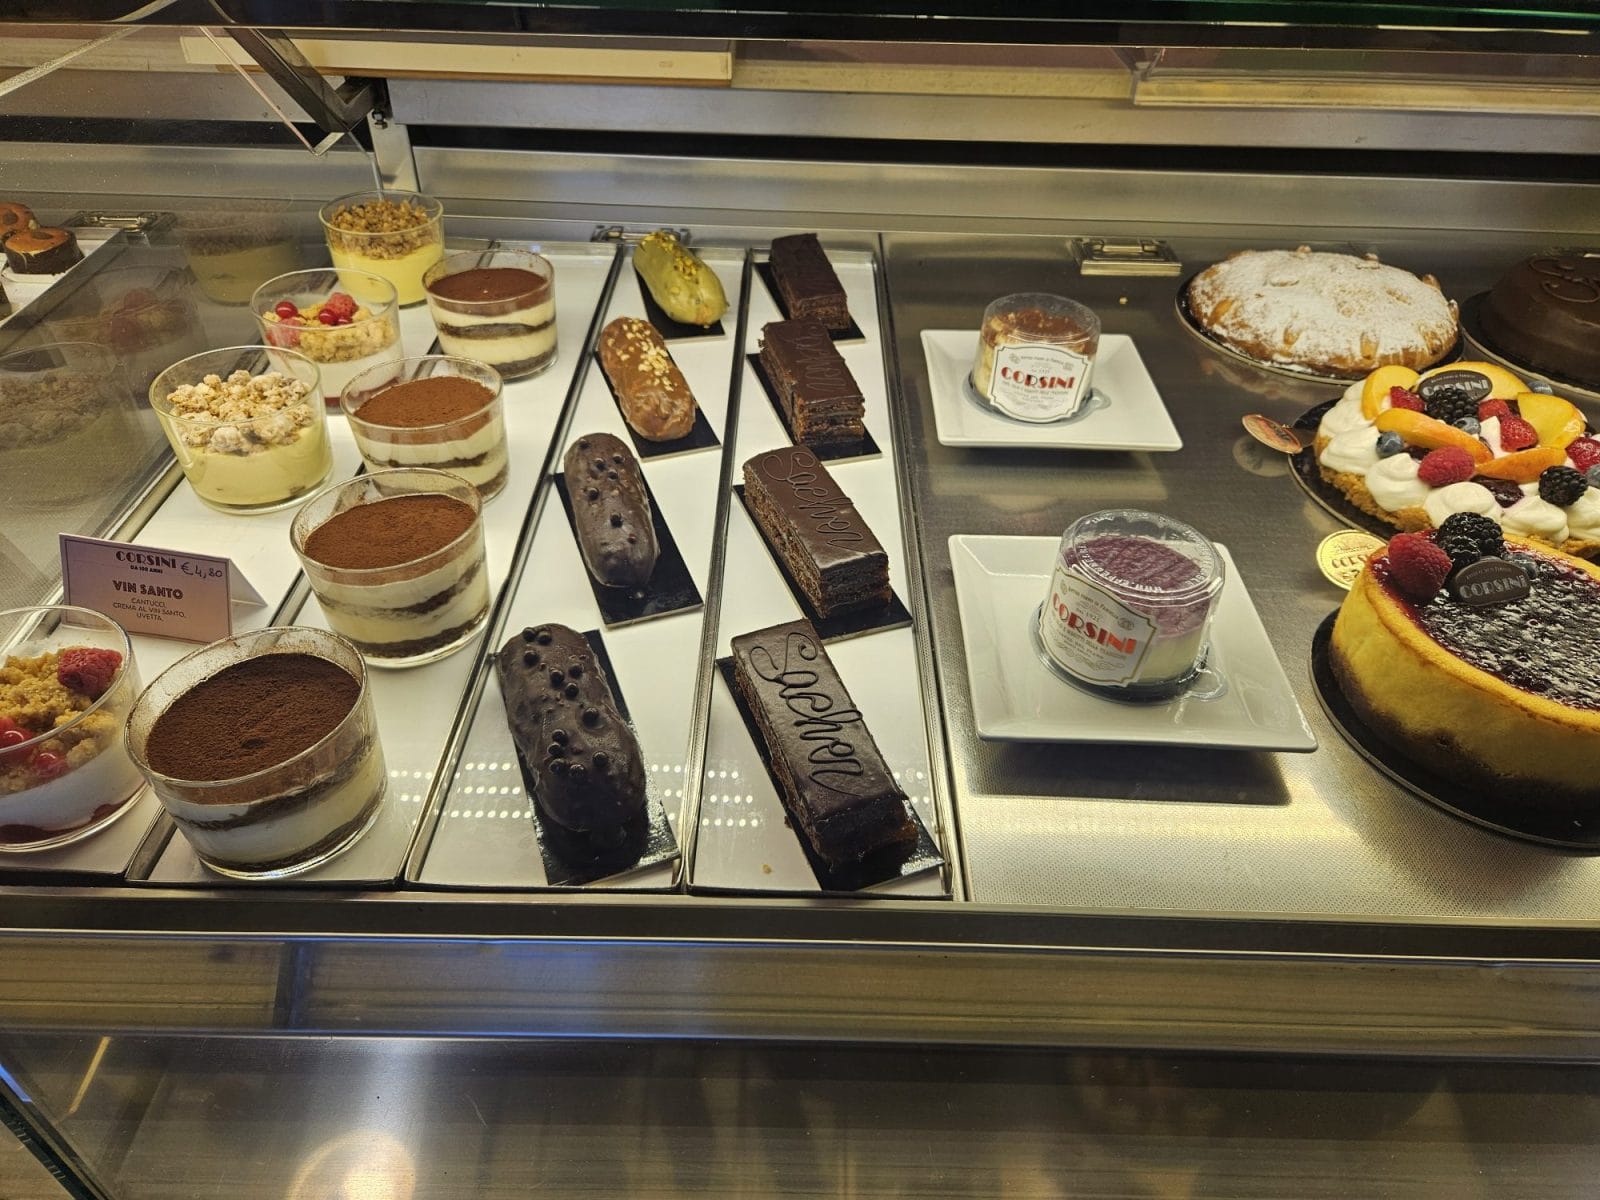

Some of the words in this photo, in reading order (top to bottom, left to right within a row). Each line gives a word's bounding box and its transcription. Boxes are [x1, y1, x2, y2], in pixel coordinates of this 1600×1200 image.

[1001, 367, 1075, 389] CORSINI
[115, 550, 177, 569] CORSINI
[112, 579, 137, 594] VIN
[140, 584, 184, 600] SANTO
[1459, 575, 1527, 599] CORSINI
[112, 602, 137, 611] CREMA
[1052, 592, 1137, 655] CORSINI
[749, 632, 864, 798] Sacher
